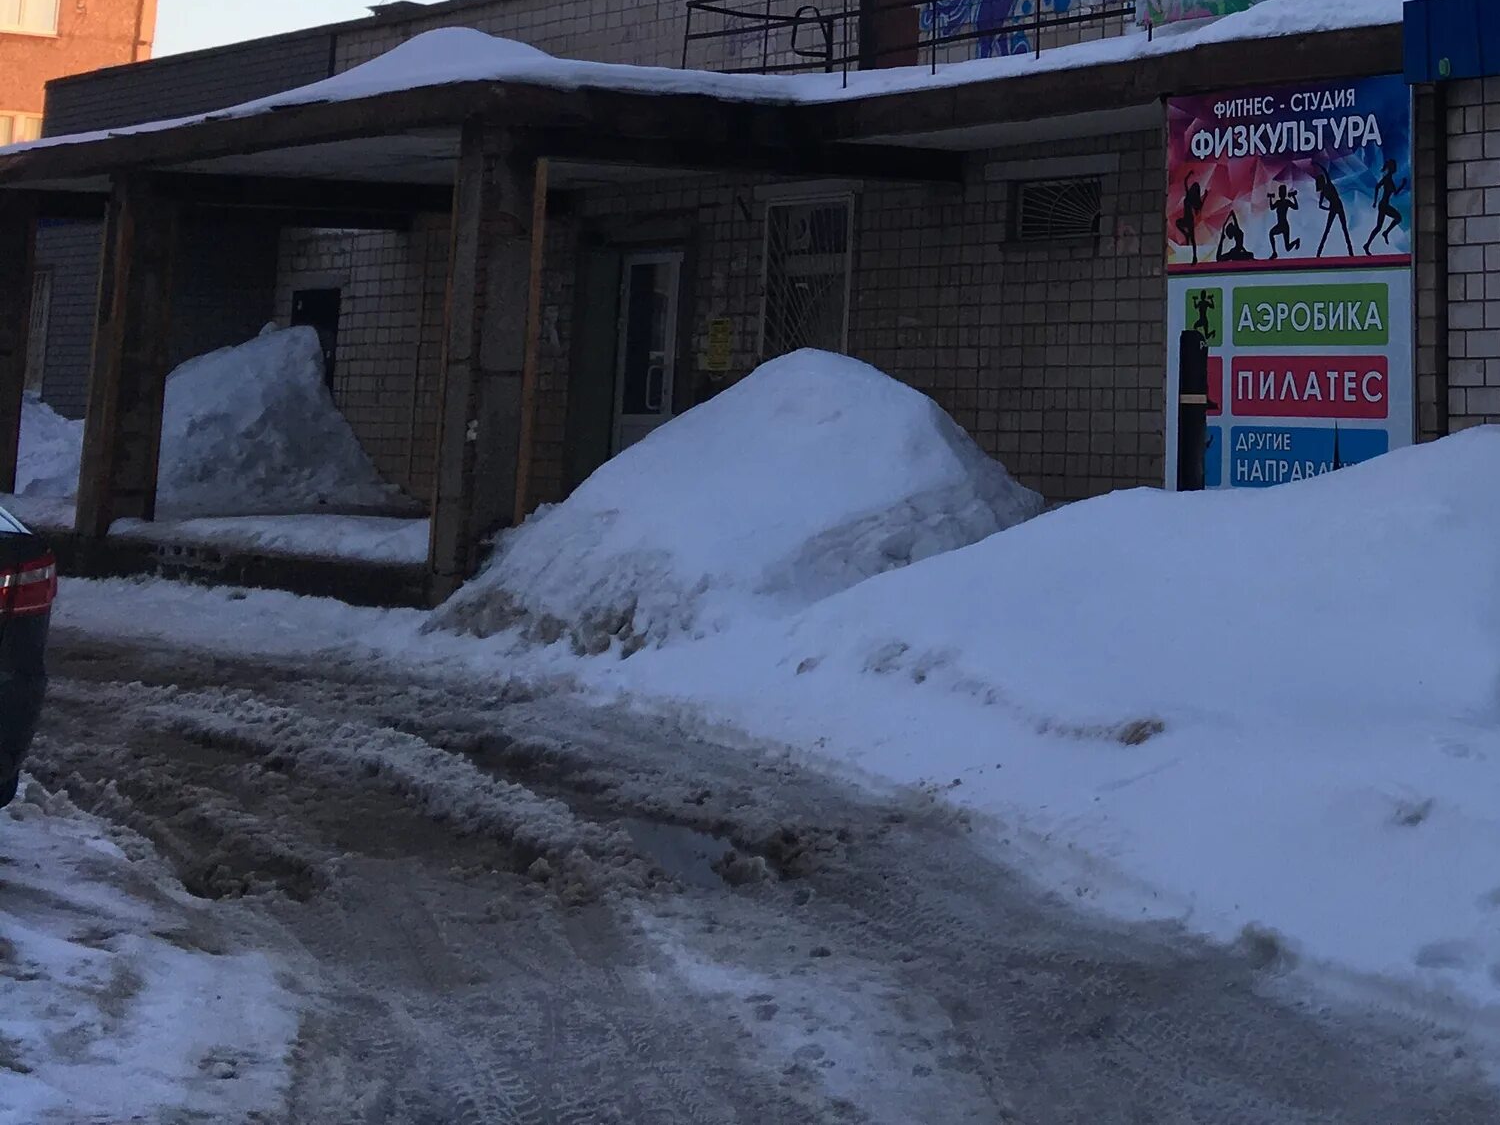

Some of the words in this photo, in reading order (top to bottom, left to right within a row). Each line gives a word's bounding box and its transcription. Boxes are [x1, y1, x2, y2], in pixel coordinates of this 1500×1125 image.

[1214, 96, 1274, 119] ФИТНЕС
[1290, 88, 1355, 113] СТУДИЯ
[1191, 114, 1383, 160] ФИЗКУЛЬТУРА
[1237, 301, 1383, 332] АЭРОБИКА
[1237, 371, 1383, 403] ПИЛАТЕС
[1235, 432, 1291, 452] ДРУГИЕ
